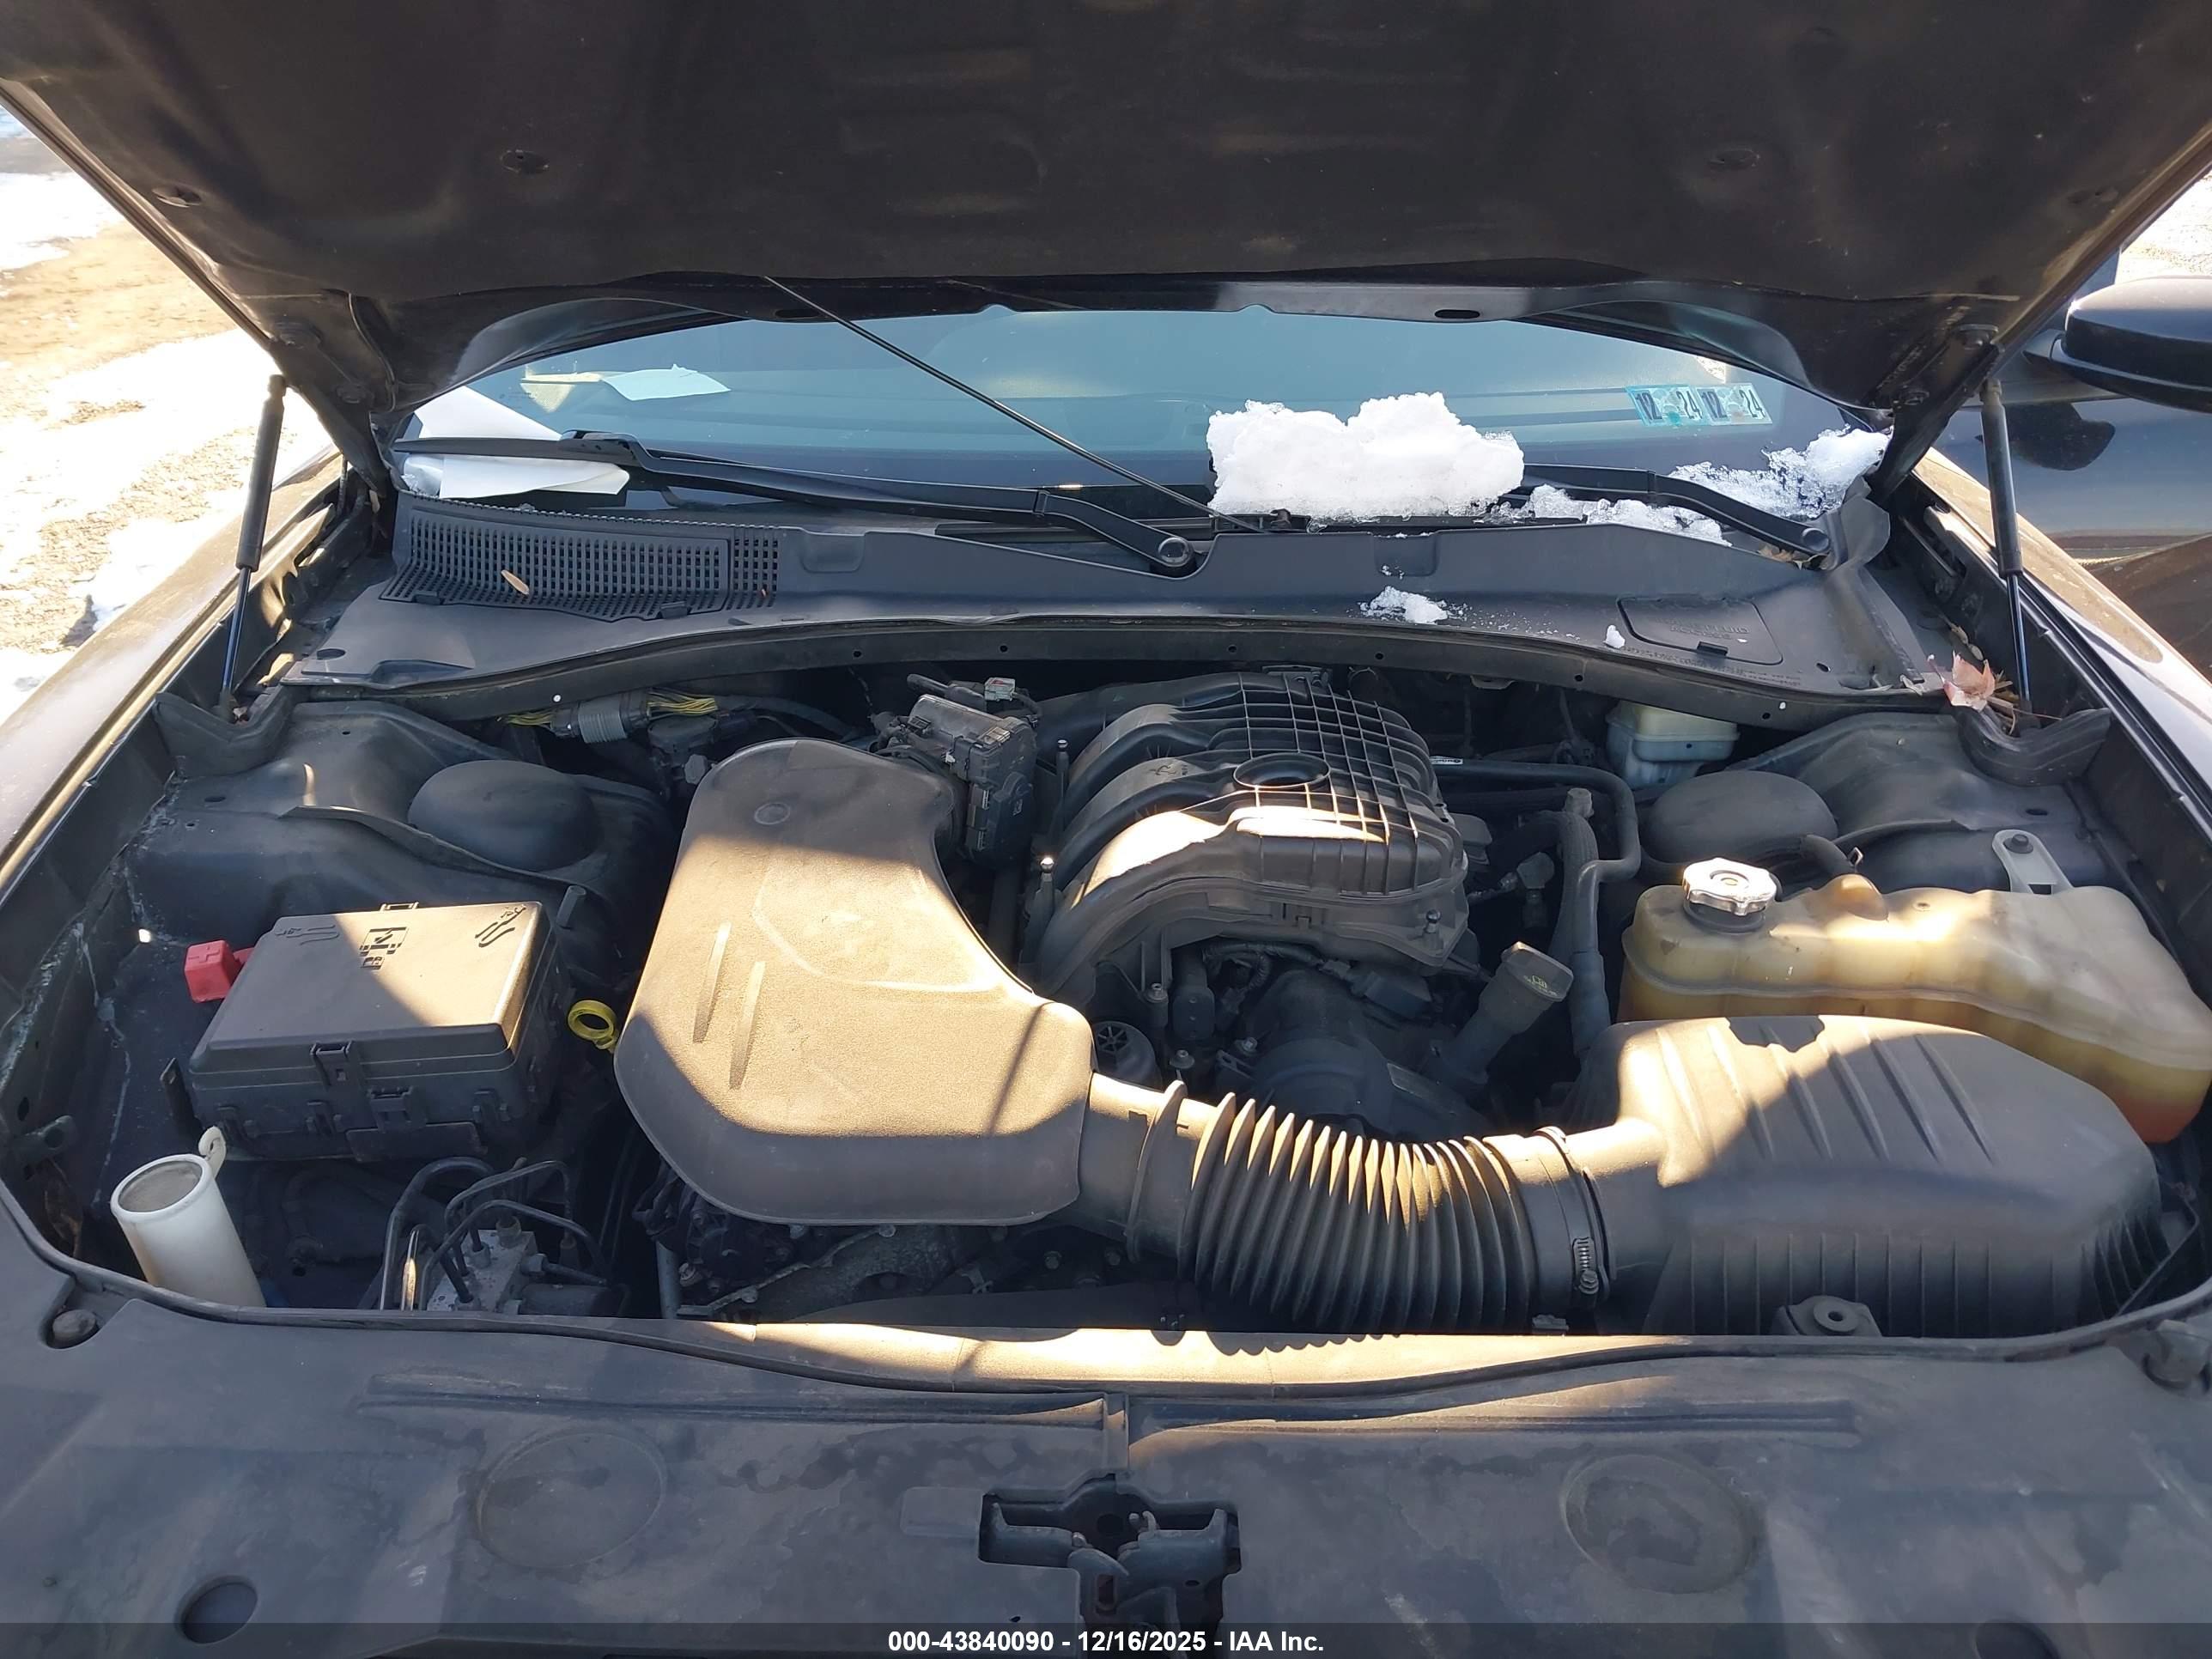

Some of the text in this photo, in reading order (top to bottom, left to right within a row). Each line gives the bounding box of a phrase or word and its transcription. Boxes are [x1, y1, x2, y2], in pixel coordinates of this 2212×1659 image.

[1635, 391, 1702, 420] 12 24
[1701, 390, 1765, 418] 12 24
